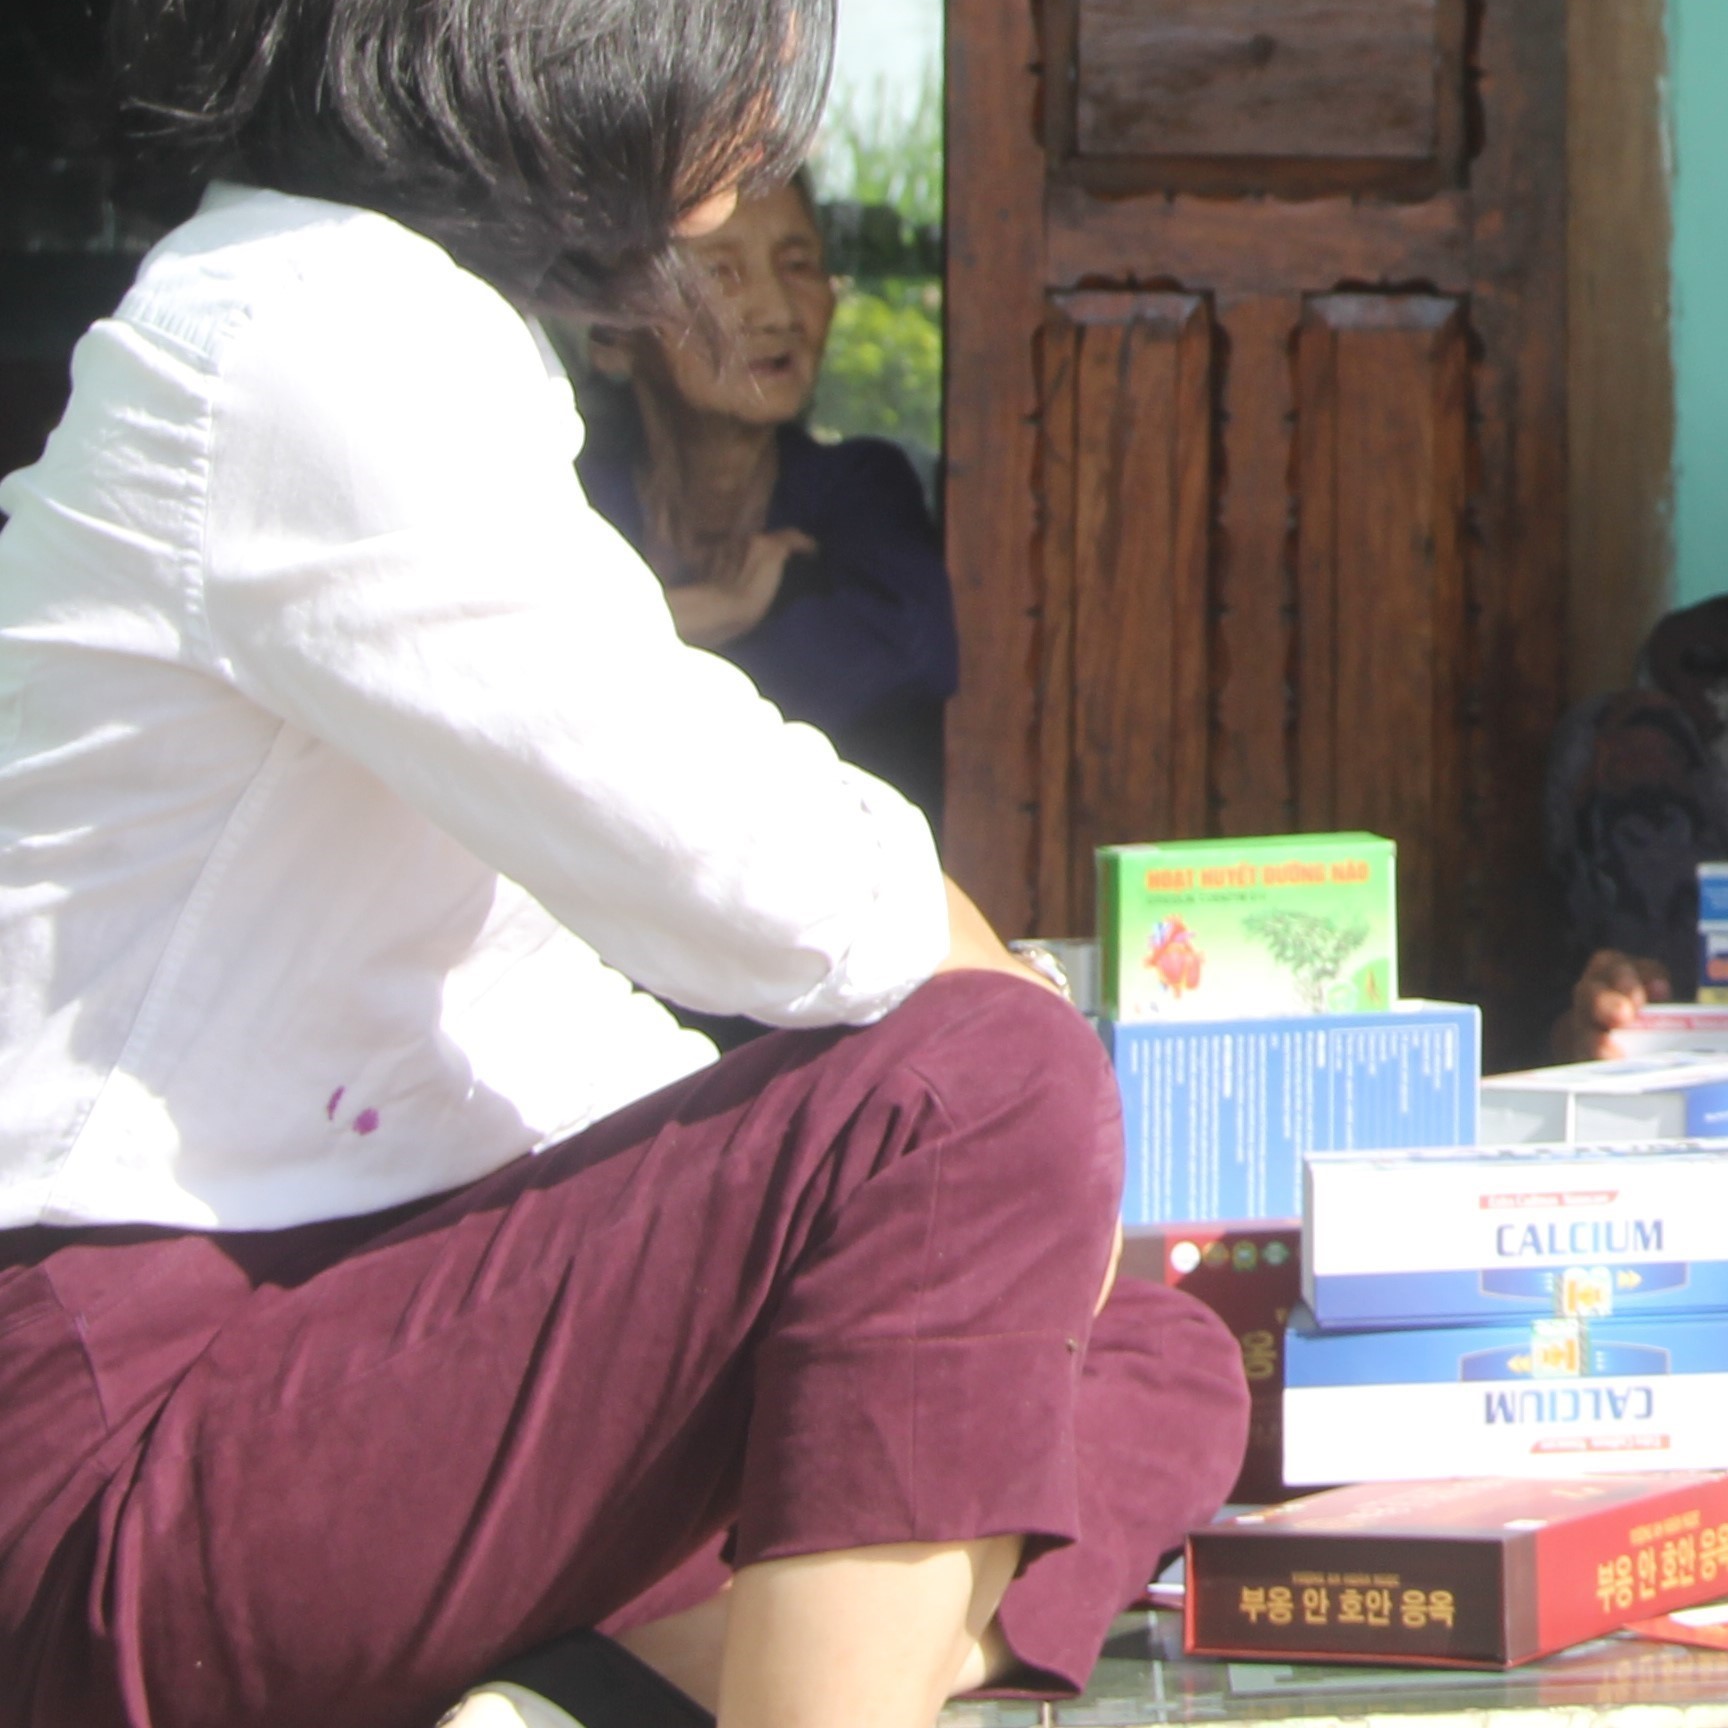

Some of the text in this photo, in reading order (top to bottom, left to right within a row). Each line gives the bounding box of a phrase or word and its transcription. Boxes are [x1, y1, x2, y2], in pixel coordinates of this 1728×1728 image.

[1496, 1218, 1665, 1257] CALCIUM
[1485, 1387, 1653, 1424] CALCIUM
[1302, 1588, 1330, 1625] 안
